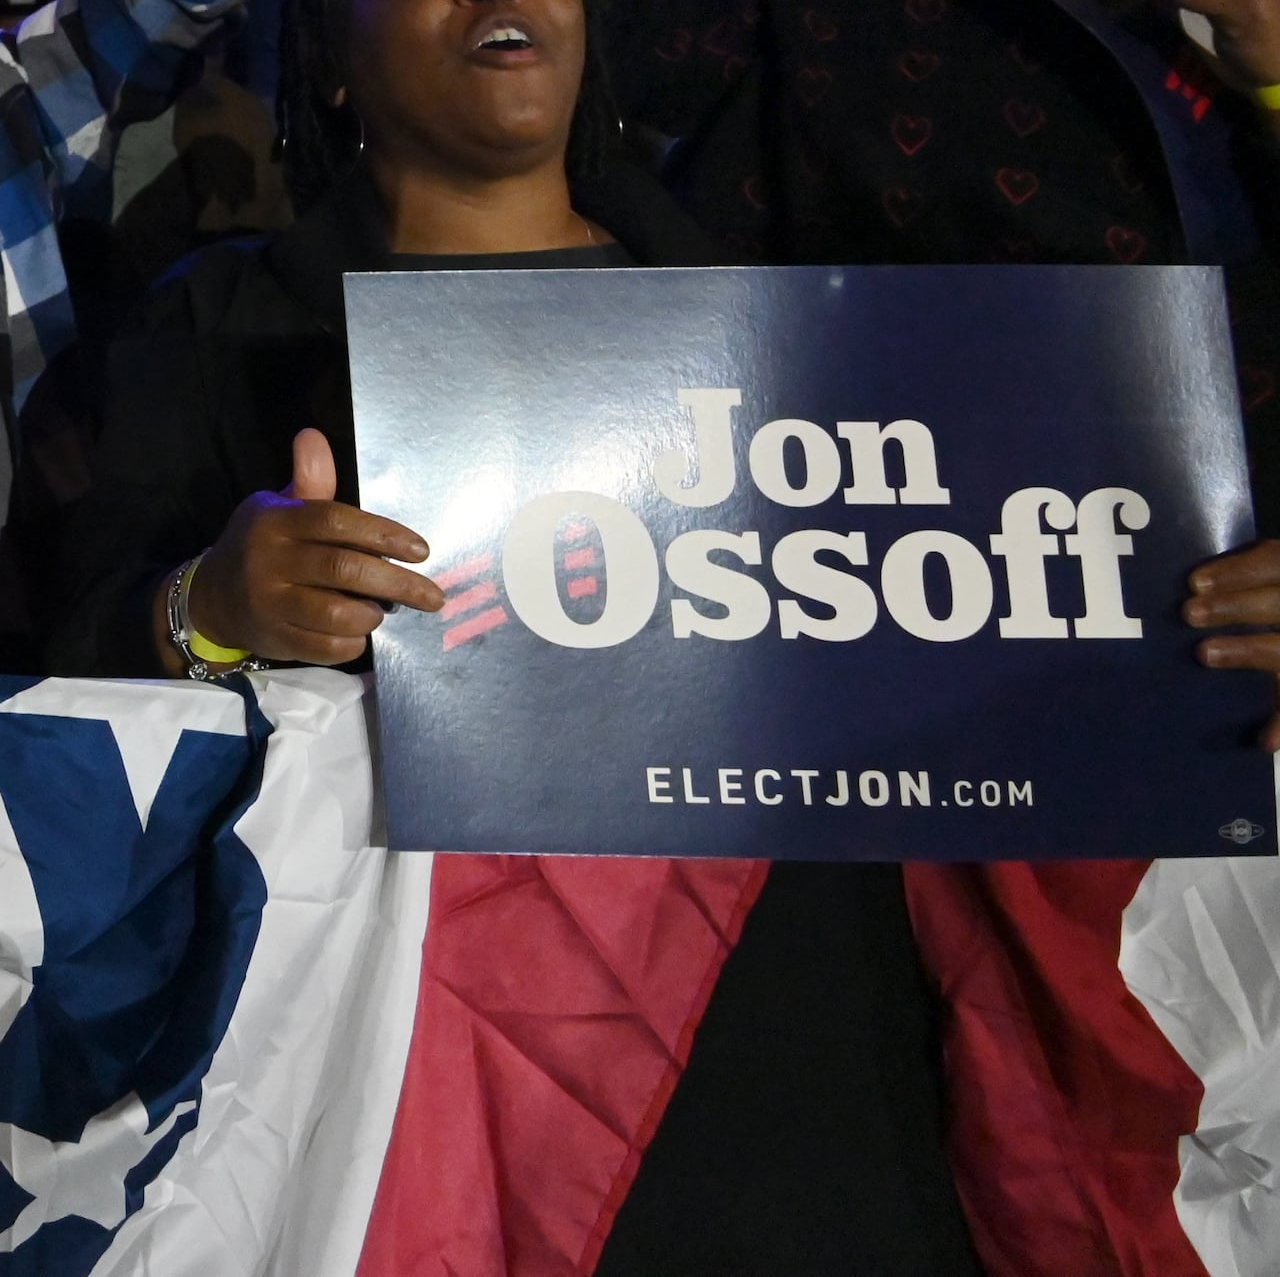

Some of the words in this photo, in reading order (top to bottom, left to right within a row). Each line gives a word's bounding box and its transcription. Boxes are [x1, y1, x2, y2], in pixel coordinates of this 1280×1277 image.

[653, 388, 950, 507] Jon
[502, 487, 1151, 649] Ossoff
[646, 767, 1034, 807] ELECTJON.COM
